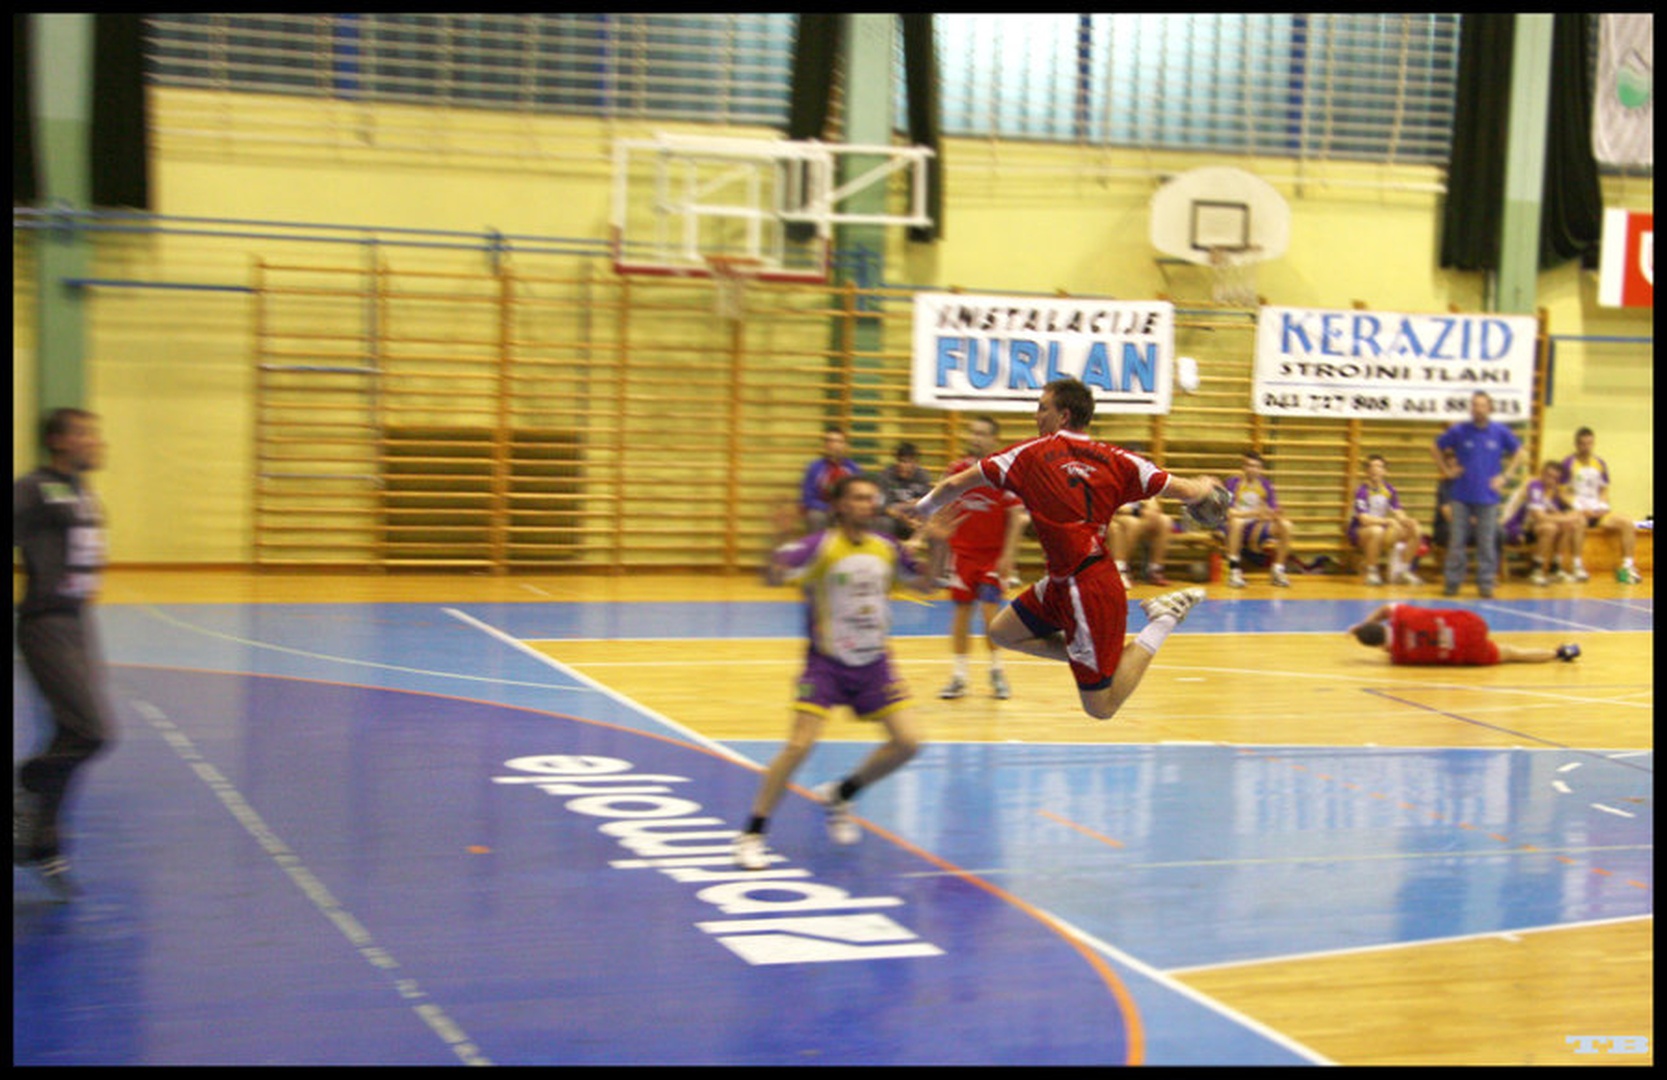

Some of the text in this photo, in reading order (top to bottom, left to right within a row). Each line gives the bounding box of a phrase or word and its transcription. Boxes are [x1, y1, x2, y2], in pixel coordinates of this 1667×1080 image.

[936, 304, 1160, 335] INSTALACIJE
[1280, 312, 1514, 361] KERAZID
[935, 335, 1158, 393] FURLAN
[1279, 361, 1511, 383] STROJNI TLAKI
